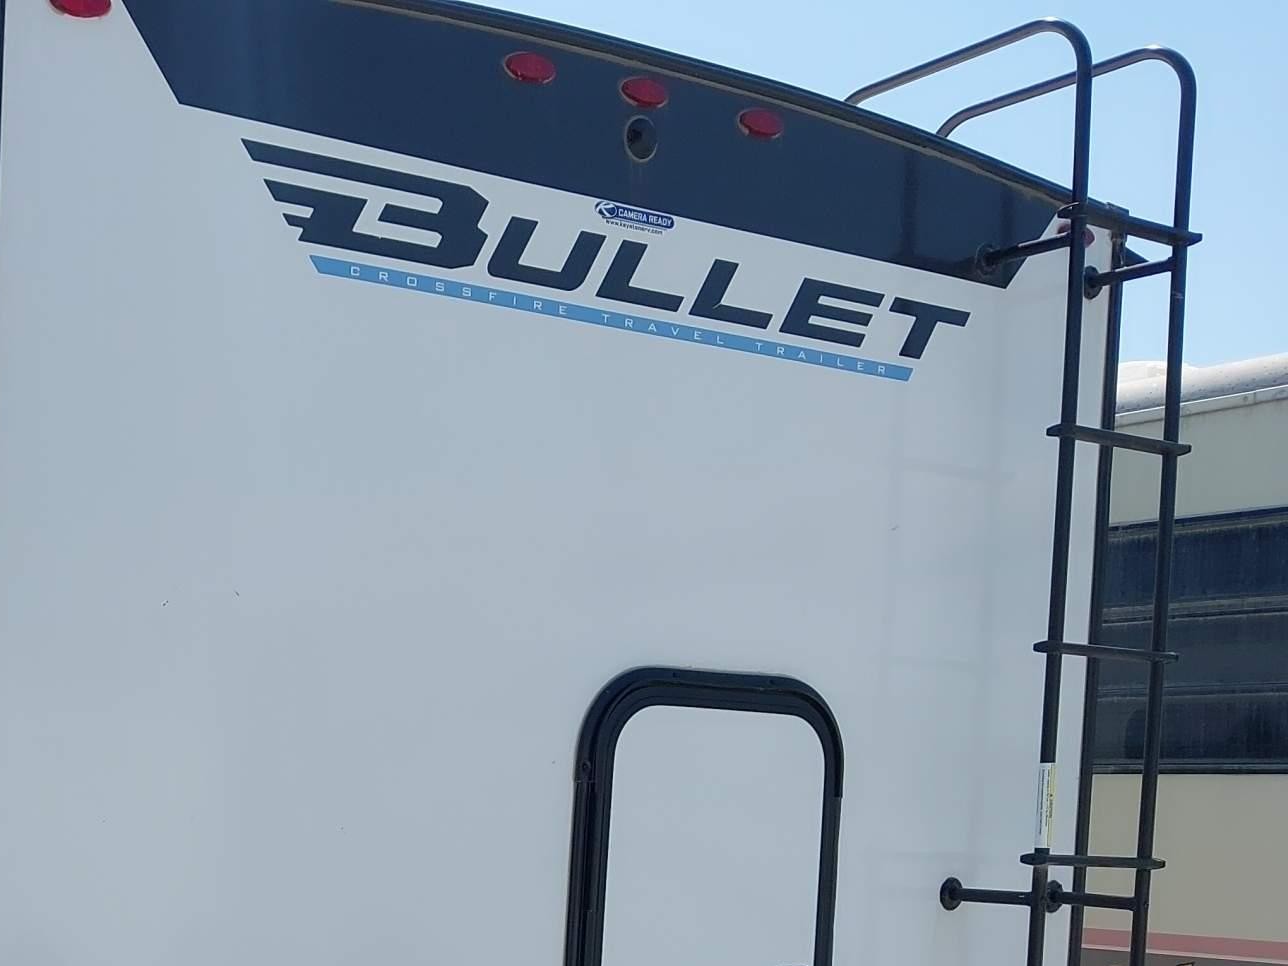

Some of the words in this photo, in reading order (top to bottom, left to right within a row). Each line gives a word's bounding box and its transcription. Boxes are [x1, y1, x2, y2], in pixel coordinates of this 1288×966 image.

[240, 137, 972, 360] BULLET
[618, 208, 648, 222] CAMERA
[648, 215, 673, 227] READY
[350, 265, 567, 315] CROSSFIRE
[600, 313, 725, 345] TRAVEL
[754, 342, 887, 375] TRAILER
